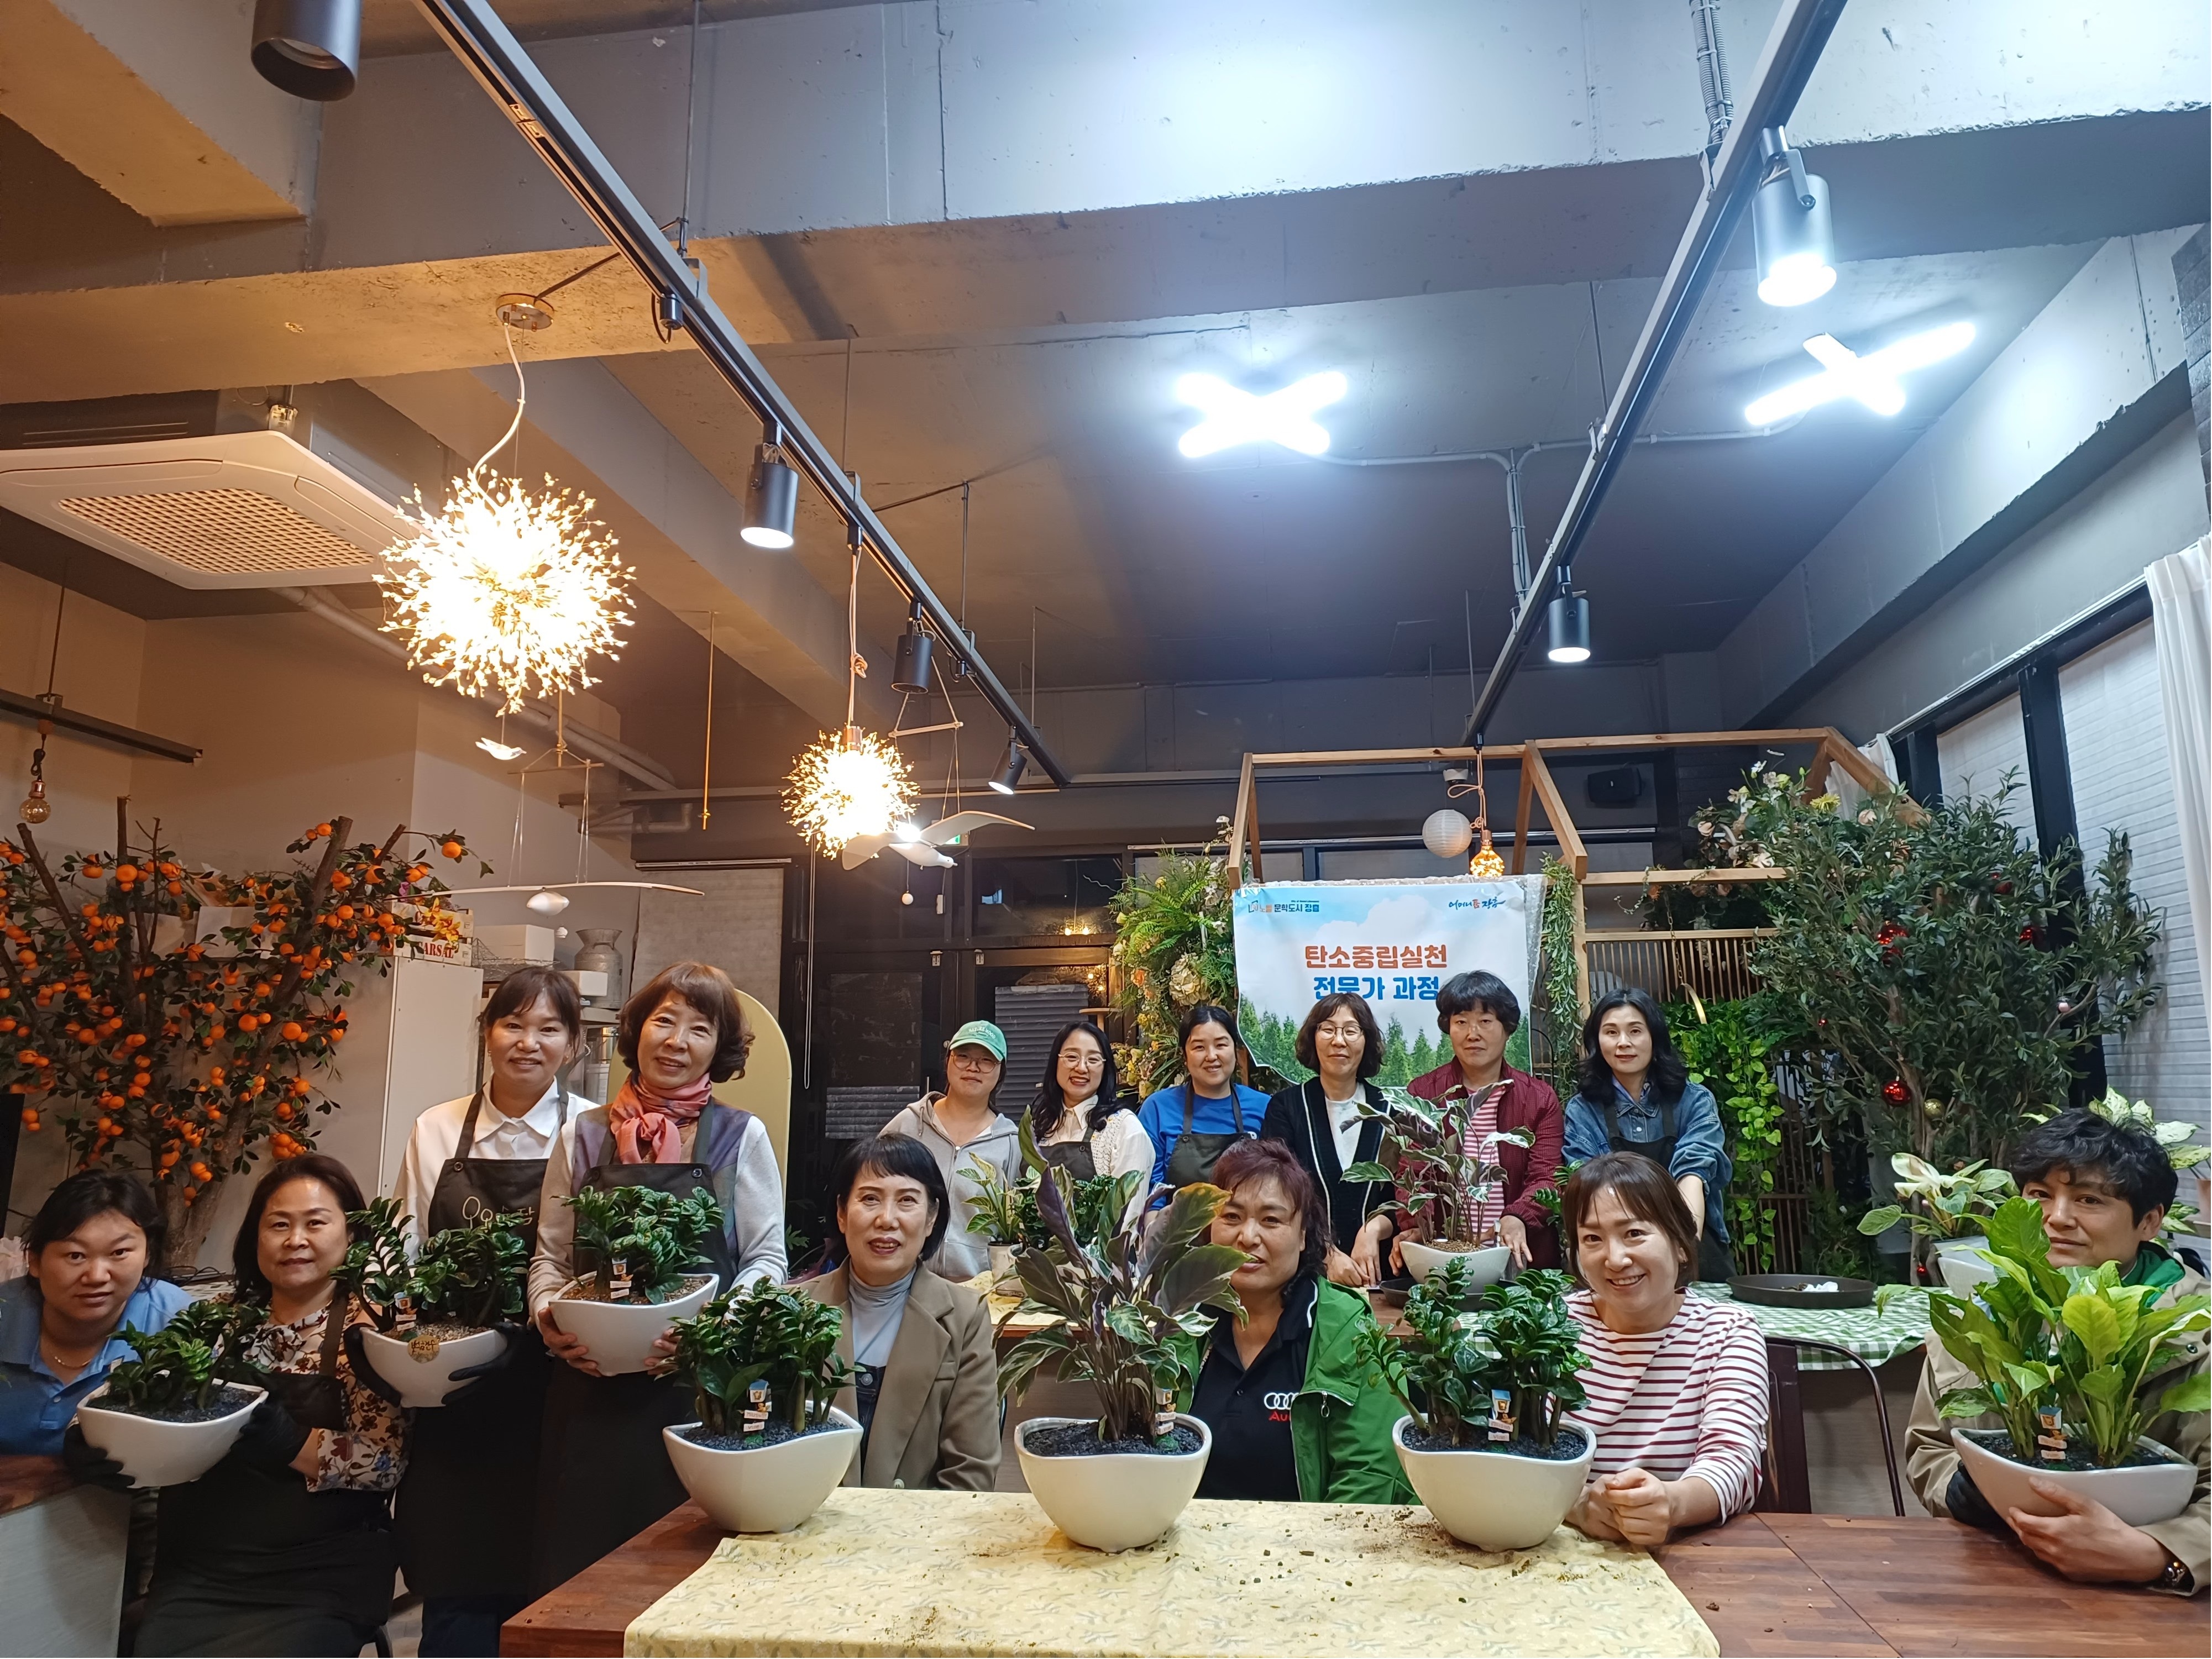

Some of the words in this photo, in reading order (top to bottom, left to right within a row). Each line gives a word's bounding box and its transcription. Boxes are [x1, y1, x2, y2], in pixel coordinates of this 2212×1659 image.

[1274, 904, 1303, 912] 문학도시
[1305, 944, 1448, 969] 탄소중립실천
[1314, 976, 1386, 1000] 전문가
[1393, 976, 1439, 1000] 과정
